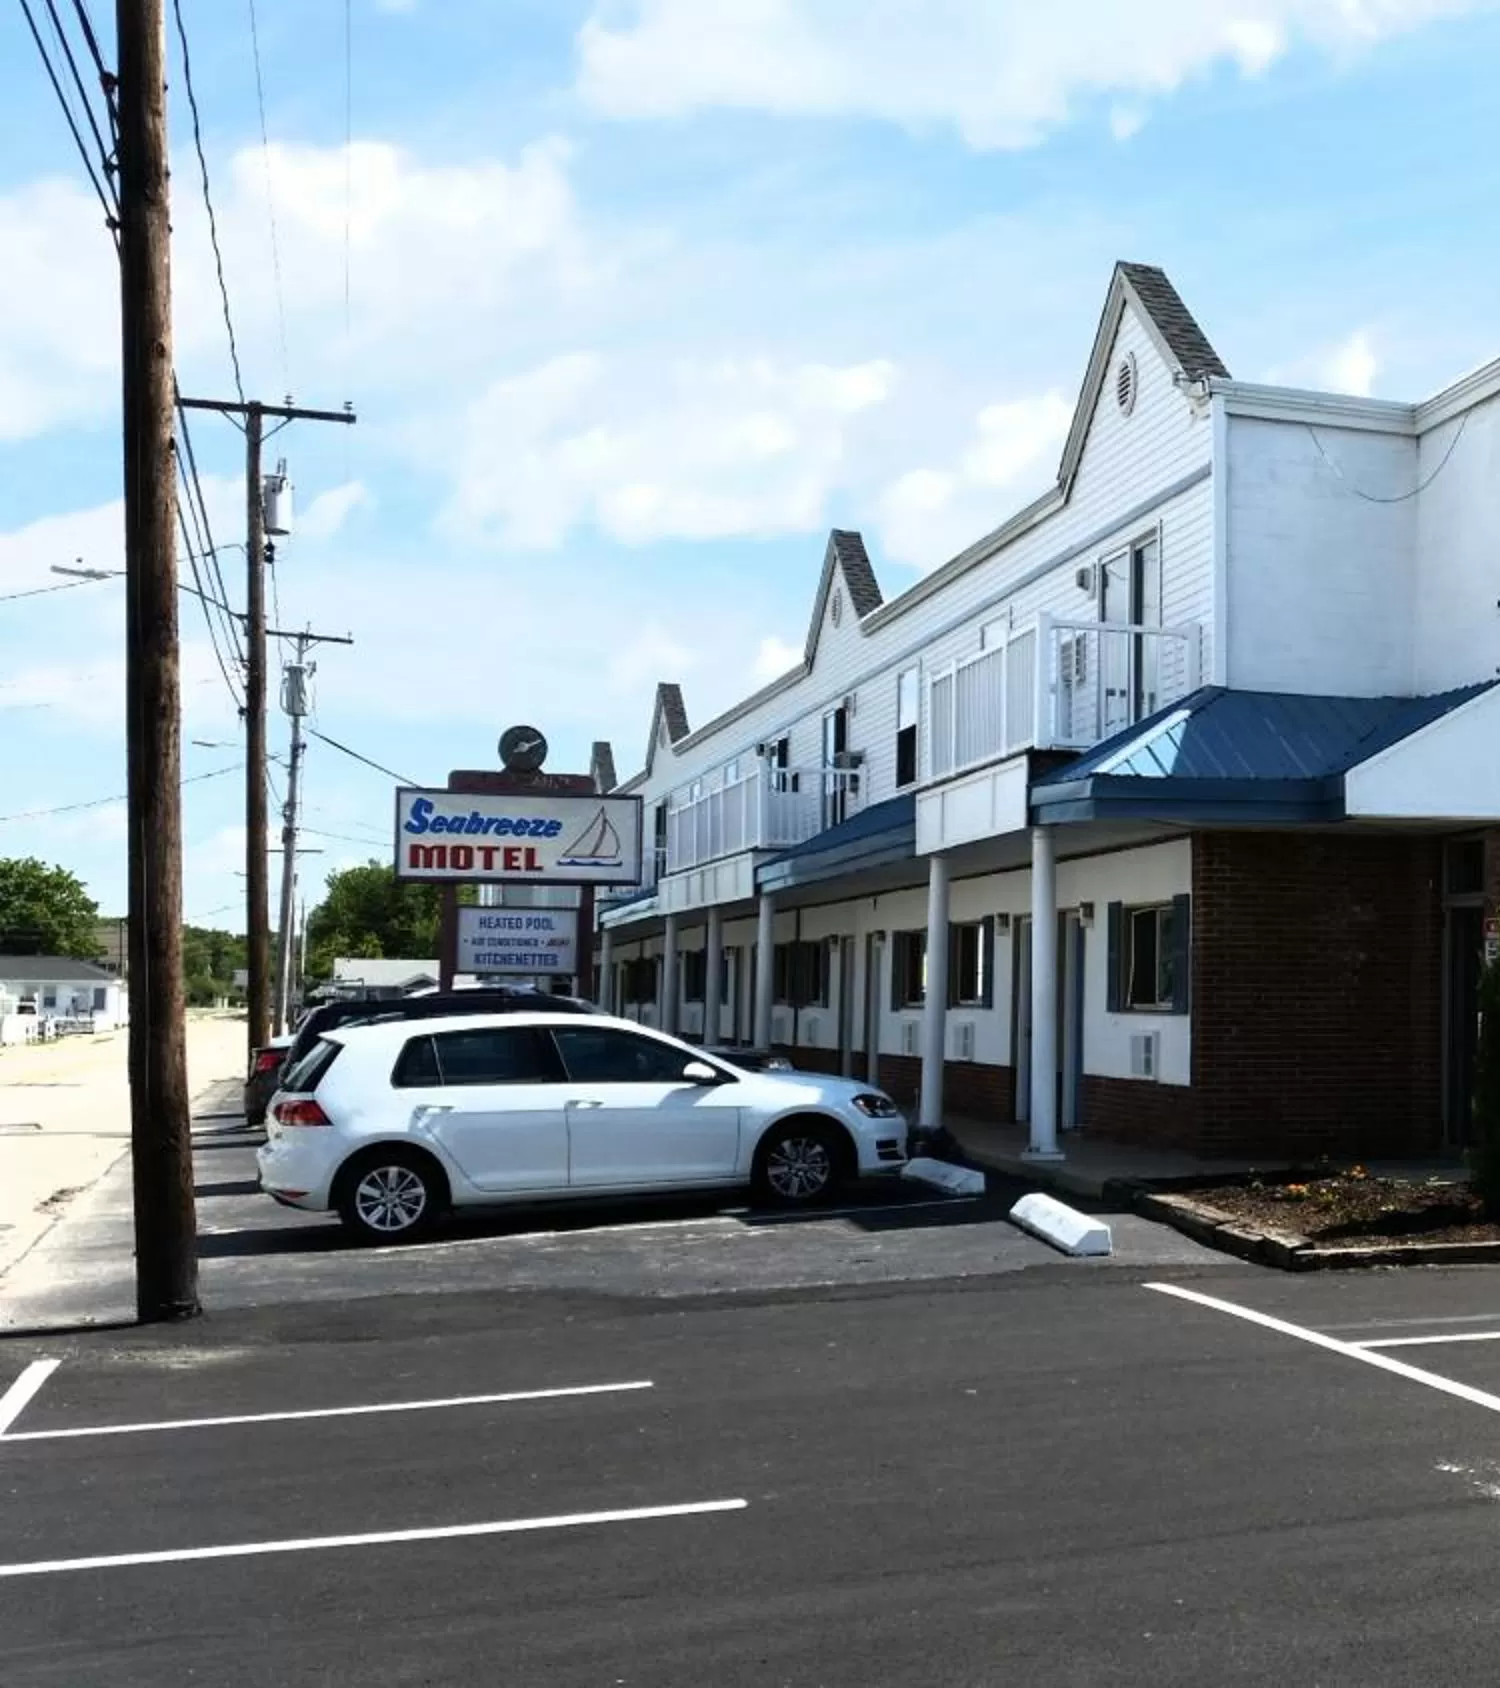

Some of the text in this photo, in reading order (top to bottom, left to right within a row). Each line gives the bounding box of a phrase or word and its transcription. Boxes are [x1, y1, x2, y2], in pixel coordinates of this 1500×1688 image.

[404, 798, 562, 838] Seabreeze
[409, 844, 543, 872] MOTEL
[479, 917, 555, 930] HEATED POOL
